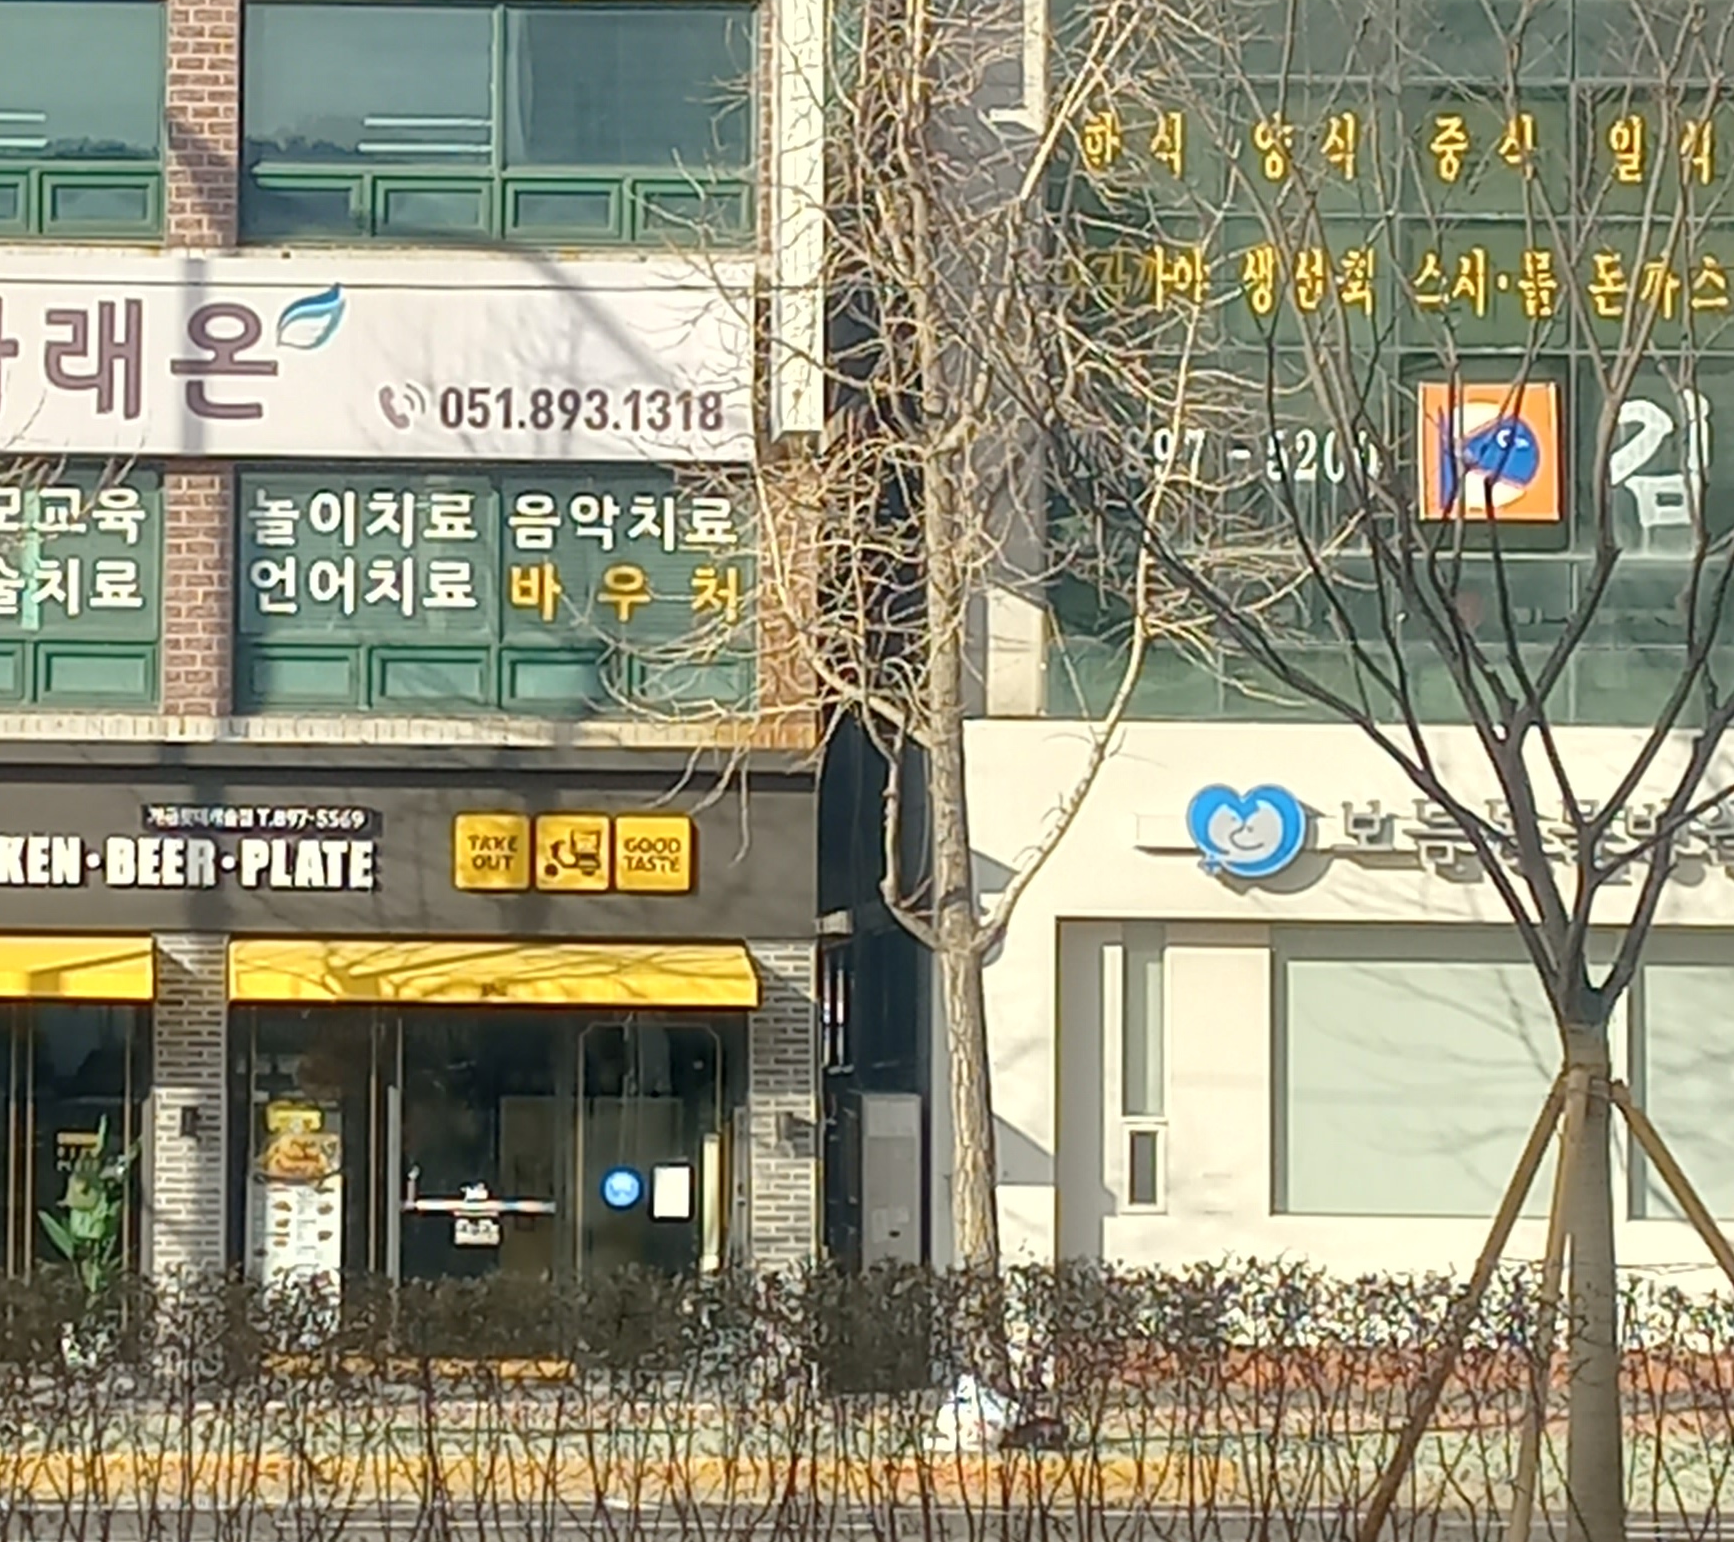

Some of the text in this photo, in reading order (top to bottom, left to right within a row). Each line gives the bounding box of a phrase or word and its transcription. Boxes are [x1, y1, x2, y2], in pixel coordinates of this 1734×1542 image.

[1243, 242, 1374, 317] 생선회
[1588, 253, 1729, 320] 돈까스
[439, 387, 724, 432] 051.893.1318
[248, 488, 738, 552] 놀이치료 음악치료
[250, 556, 478, 617] 언어치료
[468, 835, 518, 852] TAKE
[472, 855, 514, 871] OUT
[624, 837, 681, 854] GOOD
